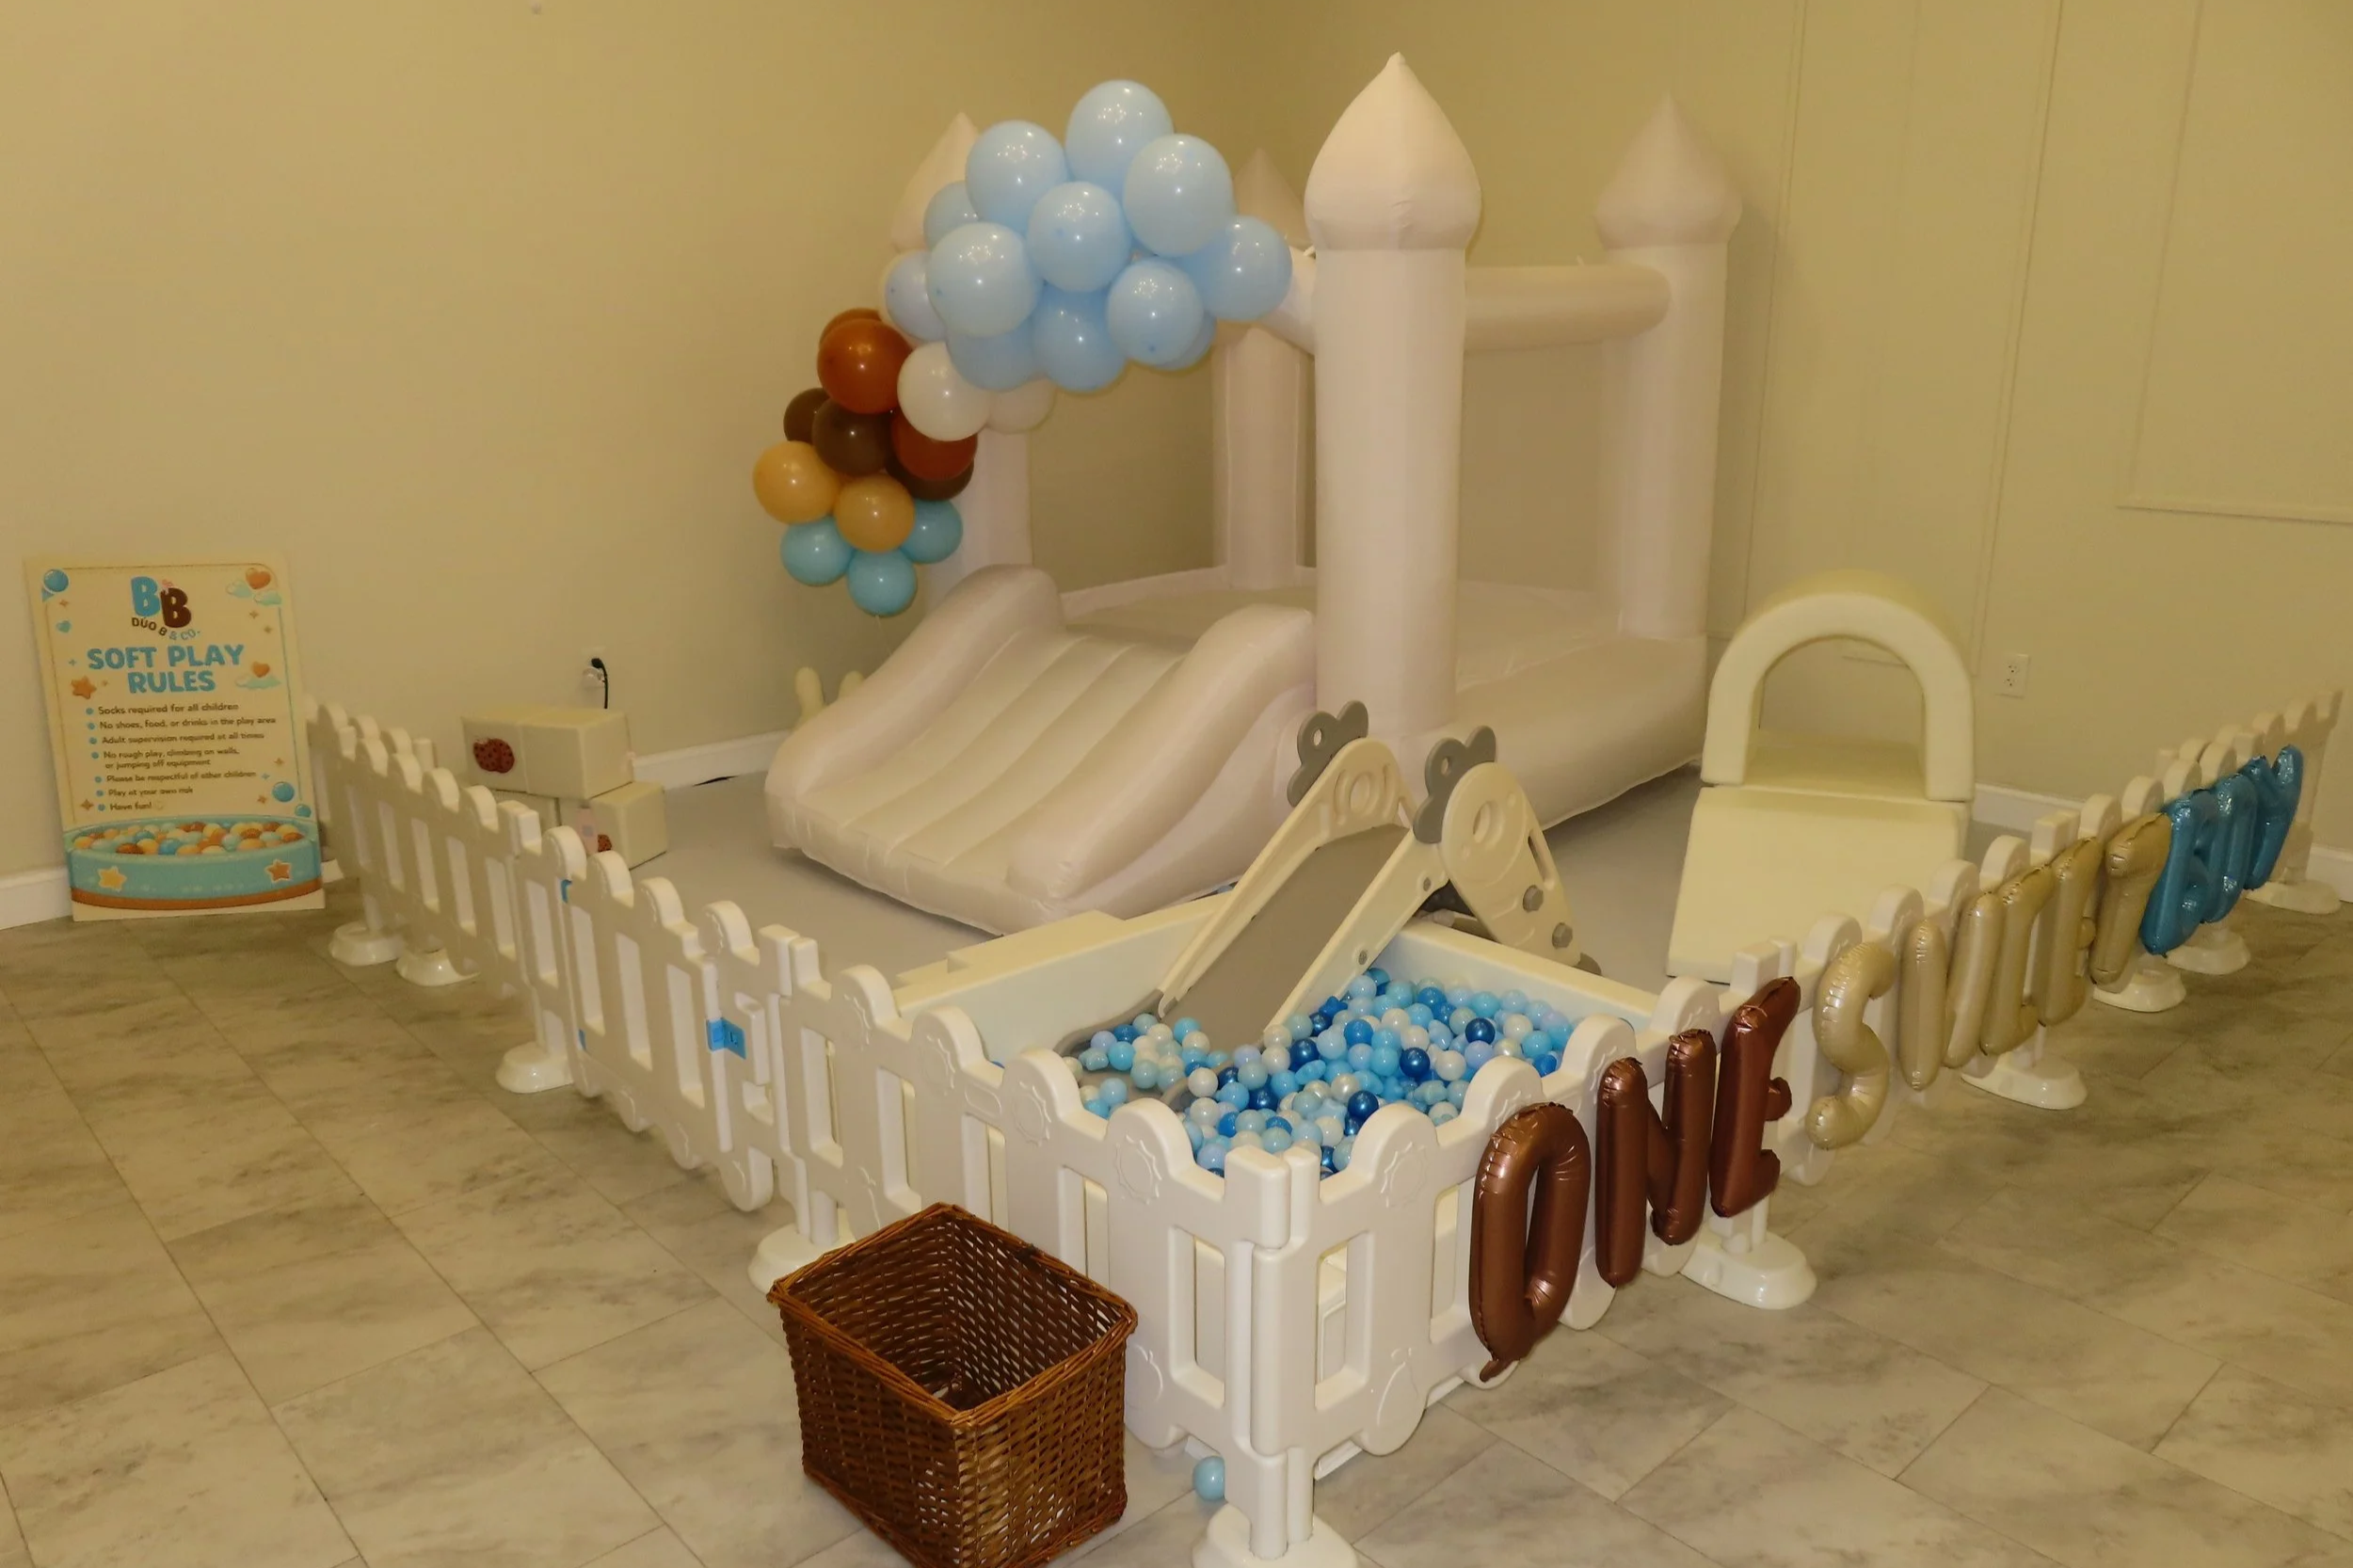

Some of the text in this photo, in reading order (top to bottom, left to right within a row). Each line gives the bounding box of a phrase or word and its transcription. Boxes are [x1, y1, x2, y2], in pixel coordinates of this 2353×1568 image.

[158, 627, 168, 636] B
[169, 631, 177, 641] &
[87, 644, 245, 669] SOFT PLAY
[128, 670, 216, 694] RULES
[98, 702, 239, 715] Socks required for all children
[99, 721, 113, 729] No
[236, 716, 254, 726] play
[102, 736, 126, 744] Adult
[128, 734, 177, 744] supervision
[179, 732, 216, 744] required
[228, 731, 239, 740] all
[119, 750, 143, 760] rough
[145, 749, 166, 758] play,
[167, 748, 201, 757] climbing
[116, 760, 151, 771] jumping
[152, 759, 165, 767] off
[166, 759, 211, 767] equipment
[147, 772, 188, 782] respectful
[223, 770, 257, 778] children
[108, 789, 127, 797] Play
[139, 789, 157, 797] your
[109, 801, 152, 810] Have fun!
[1469, 975, 1801, 1383] ONE
[1804, 812, 2172, 1150] SWEET
